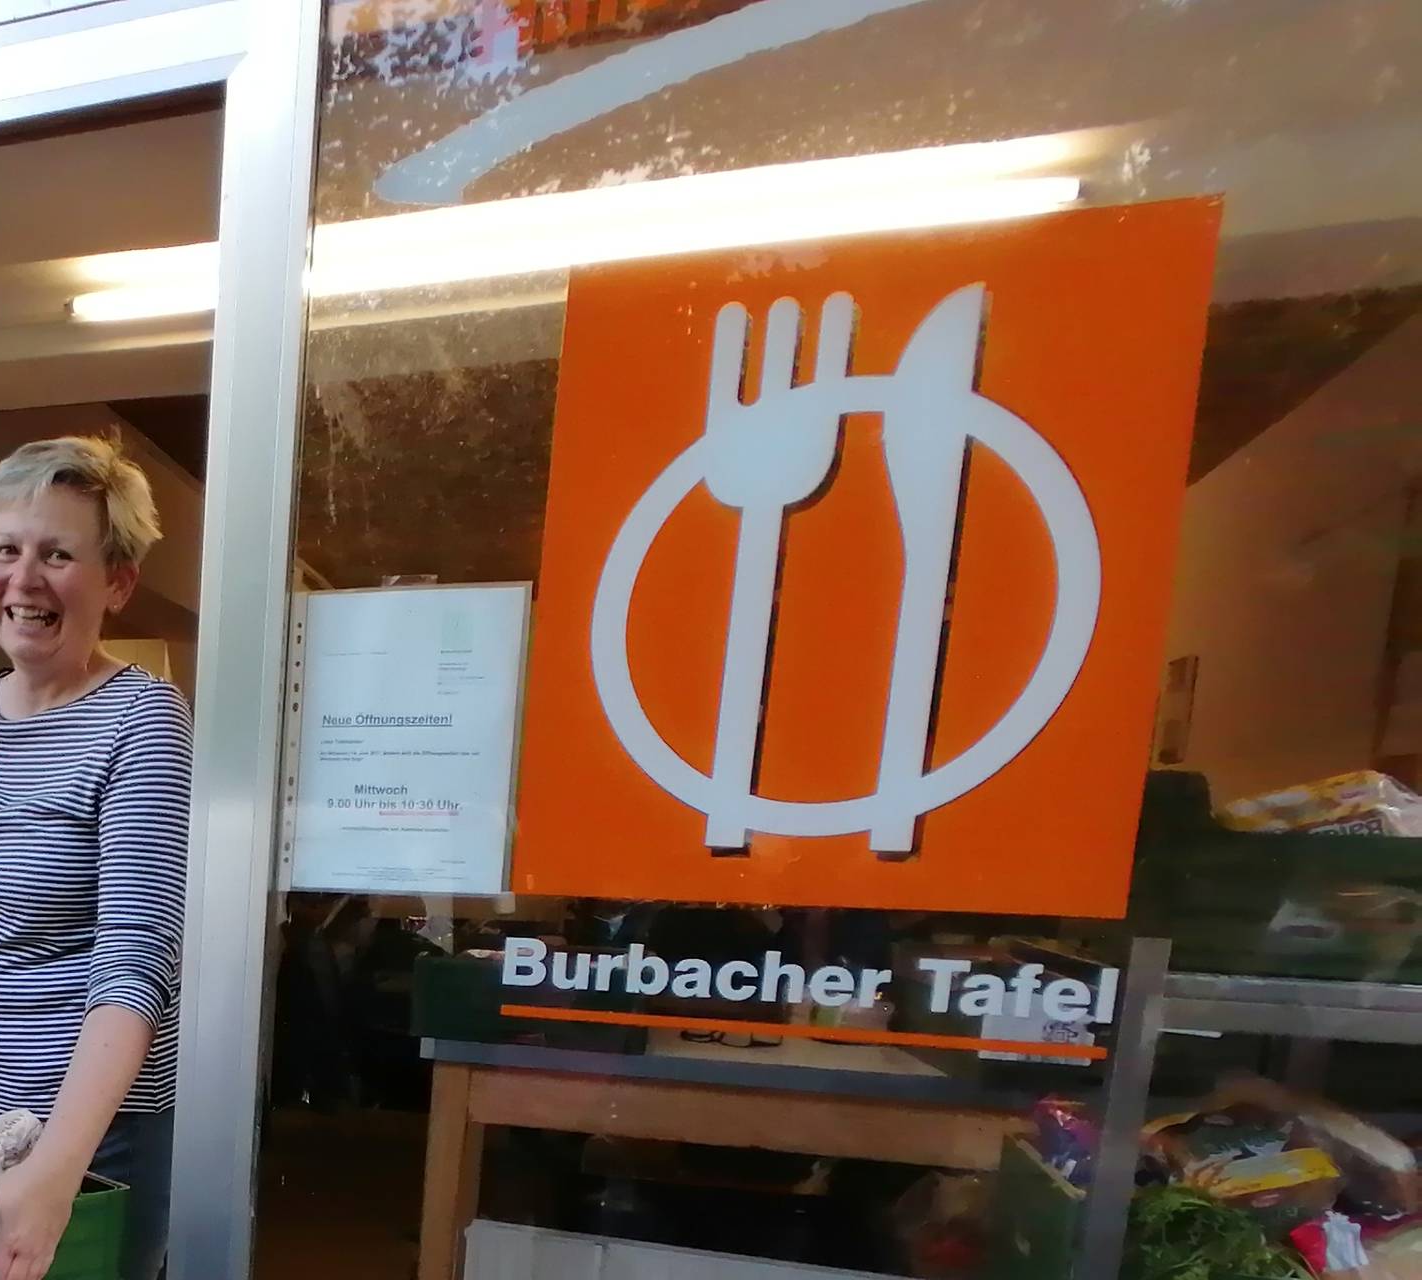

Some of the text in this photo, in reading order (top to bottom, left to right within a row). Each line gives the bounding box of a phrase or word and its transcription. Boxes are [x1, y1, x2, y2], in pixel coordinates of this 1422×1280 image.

[322, 712, 453, 727] Neue Öffnungszeiten!
[354, 784, 408, 795] Mittwoch
[355, 799, 375, 809] Uhr
[379, 799, 398, 810] bis
[501, 937, 1120, 1024] Burbacher Tafel
